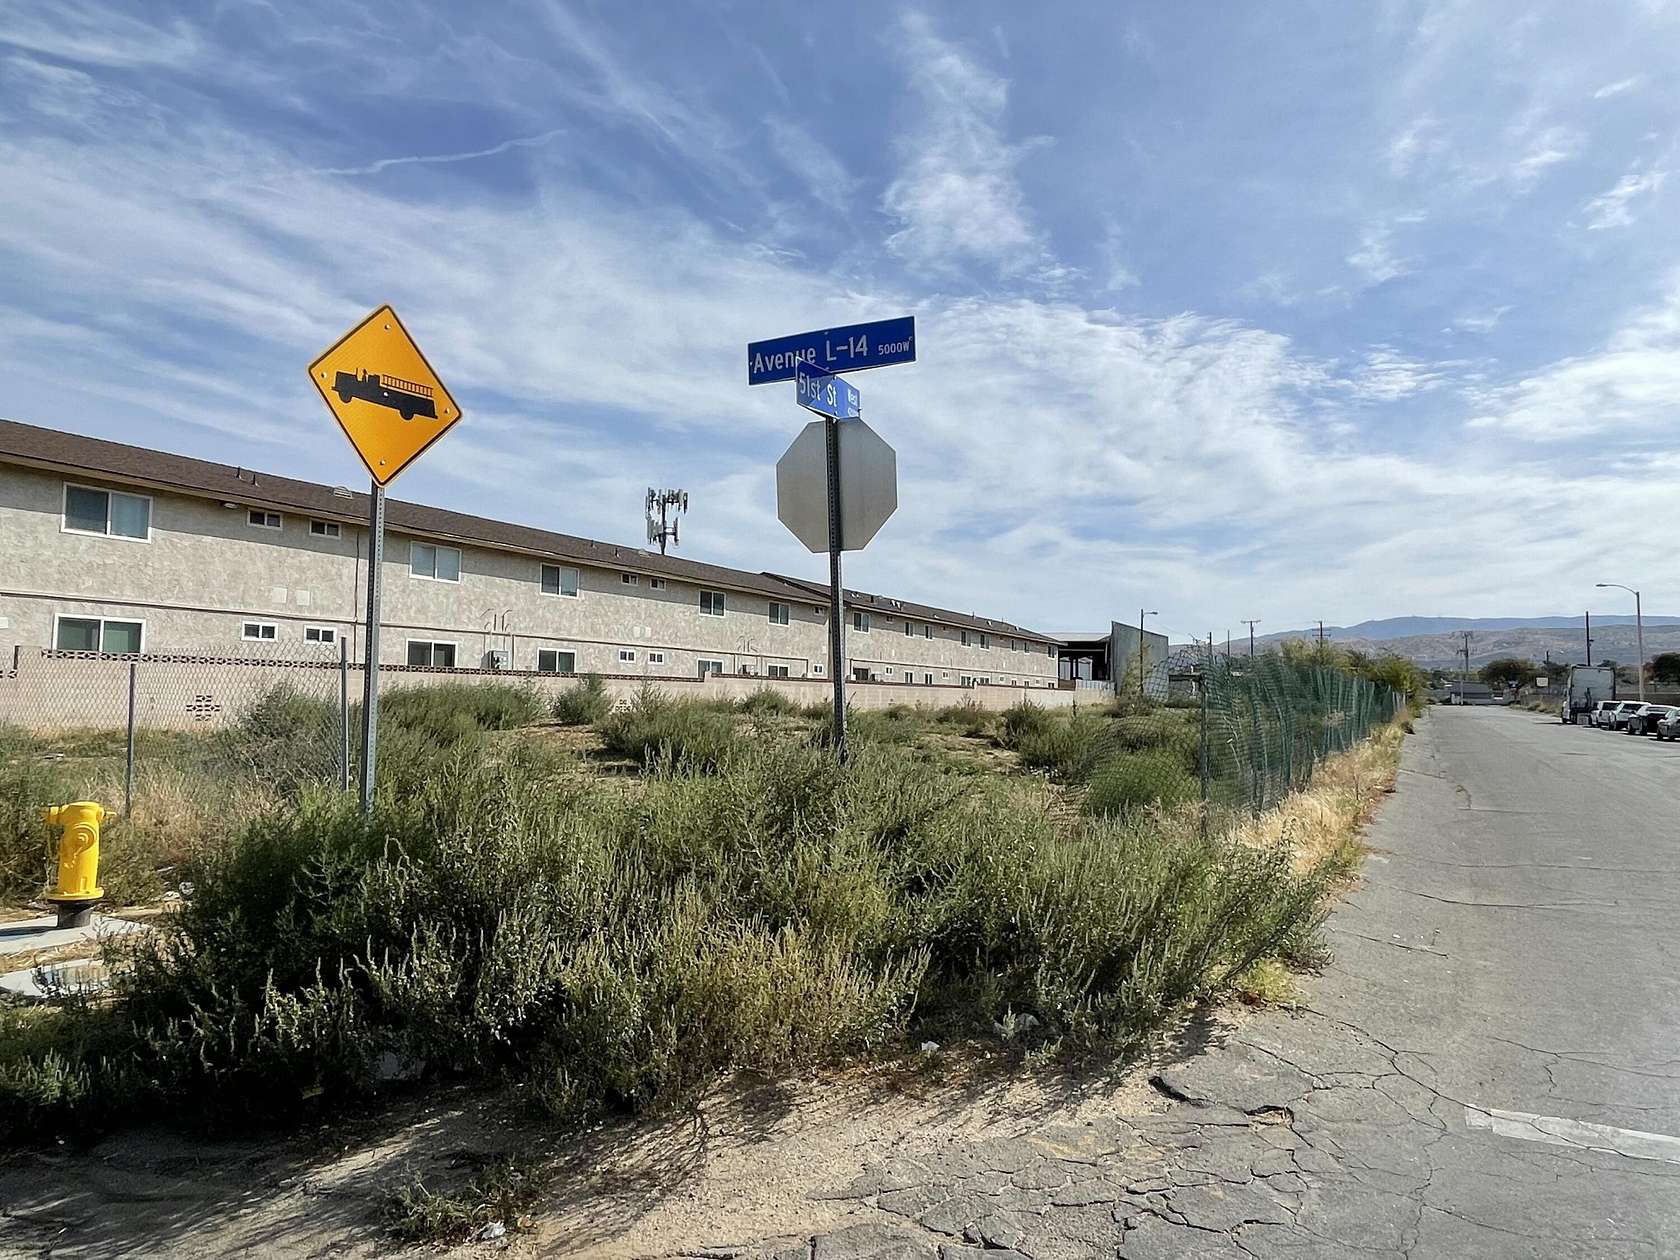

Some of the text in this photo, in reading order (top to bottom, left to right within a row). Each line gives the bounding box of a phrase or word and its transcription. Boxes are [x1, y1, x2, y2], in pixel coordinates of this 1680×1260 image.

[825, 334, 868, 362] L-14
[878, 341, 910, 356] 5000W
[799, 371, 837, 408] 51st St
